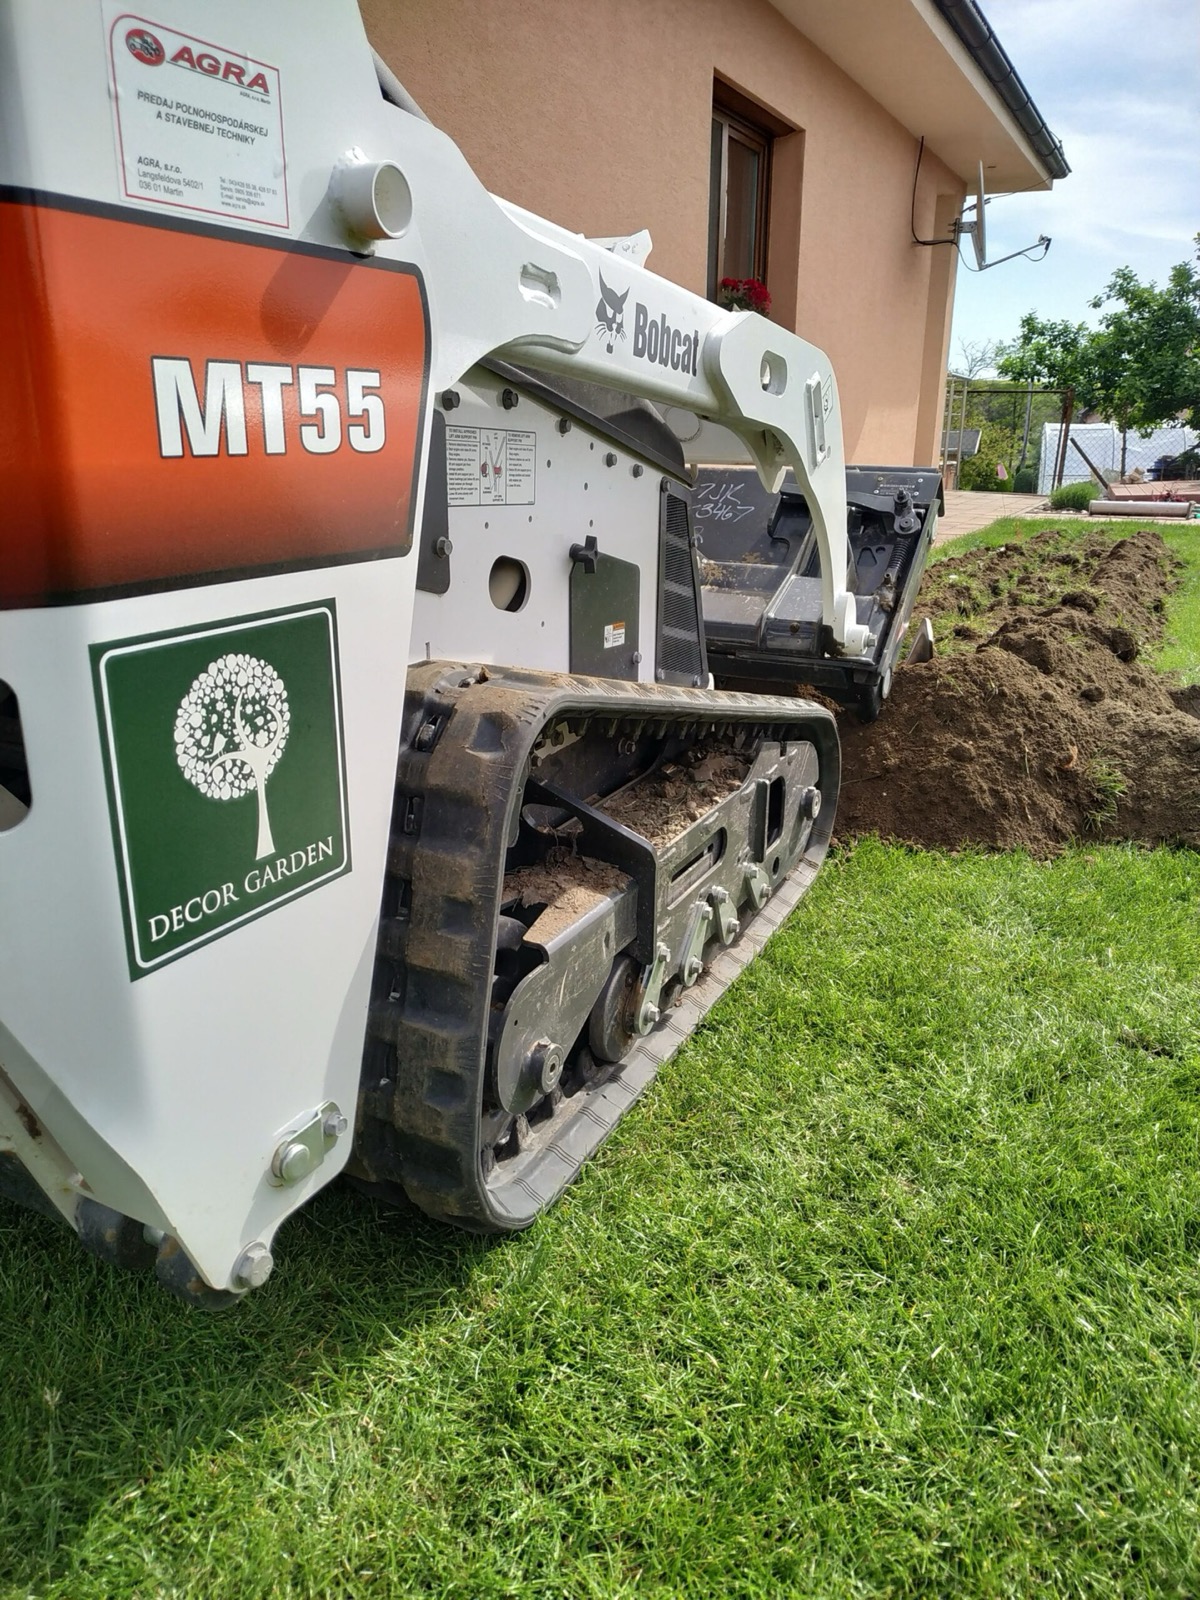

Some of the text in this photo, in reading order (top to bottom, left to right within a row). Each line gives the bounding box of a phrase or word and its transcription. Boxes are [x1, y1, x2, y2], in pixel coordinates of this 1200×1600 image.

[170, 46, 269, 94] AGRA
[137, 90, 268, 137] PREDAJ POĽNOHOSPODÁRSKEJ
[156, 111, 256, 145] A STAVEBNEJ TECHNIKY
[137, 156, 182, 174] AGRA, s.r.o.
[153, 183, 161, 192] 01
[163, 185, 184, 197] Martin
[633, 302, 698, 377] Bobcat
[151, 355, 386, 458] MT55
[148, 836, 333, 942] DECOR GARDEN
